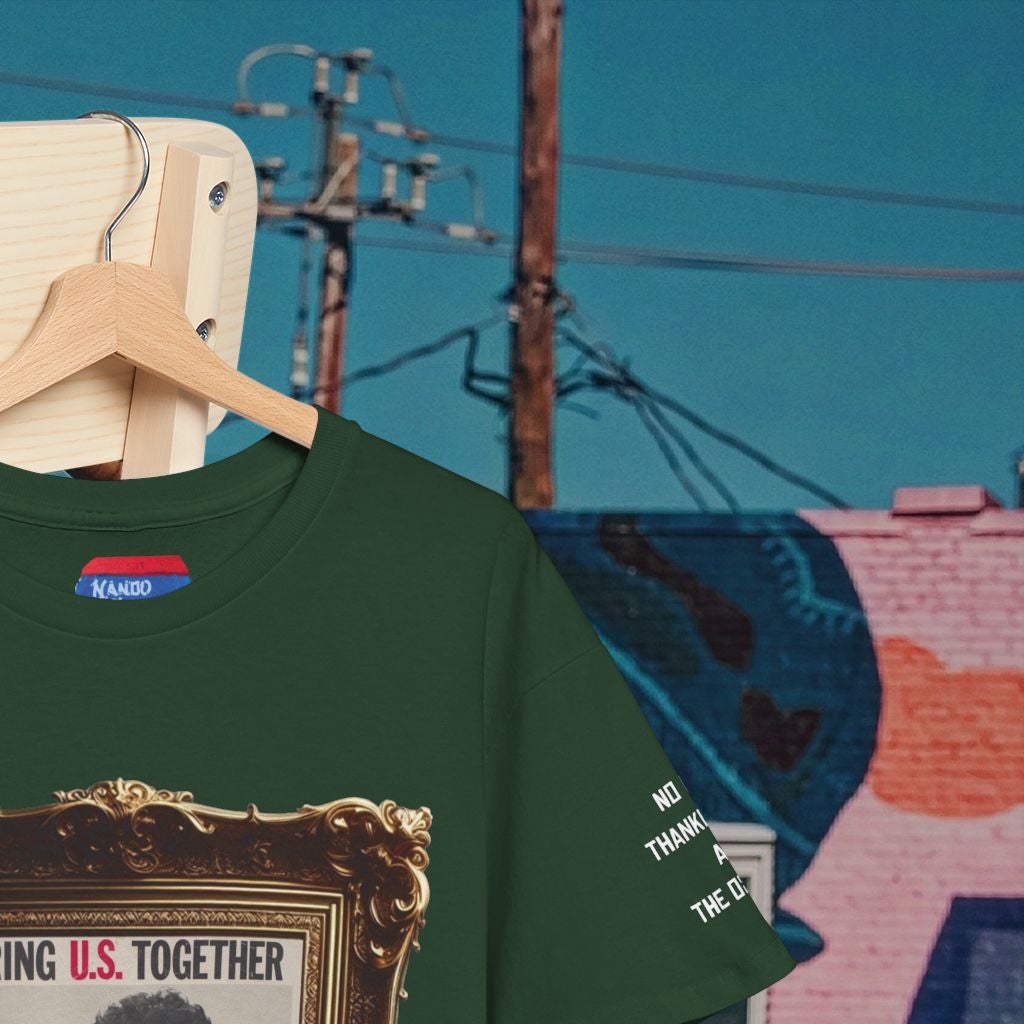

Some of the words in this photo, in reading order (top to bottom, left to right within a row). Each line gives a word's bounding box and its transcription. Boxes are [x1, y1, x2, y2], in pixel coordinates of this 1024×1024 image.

[91, 578, 152, 600] NANDO
[651, 780, 682, 812] NO
[644, 808, 709, 862] THANK
[689, 888, 731, 923] THE
[726, 875, 749, 901] O
[70, 939, 123, 981] U.S.
[131, 939, 284, 981] TOGETHER
